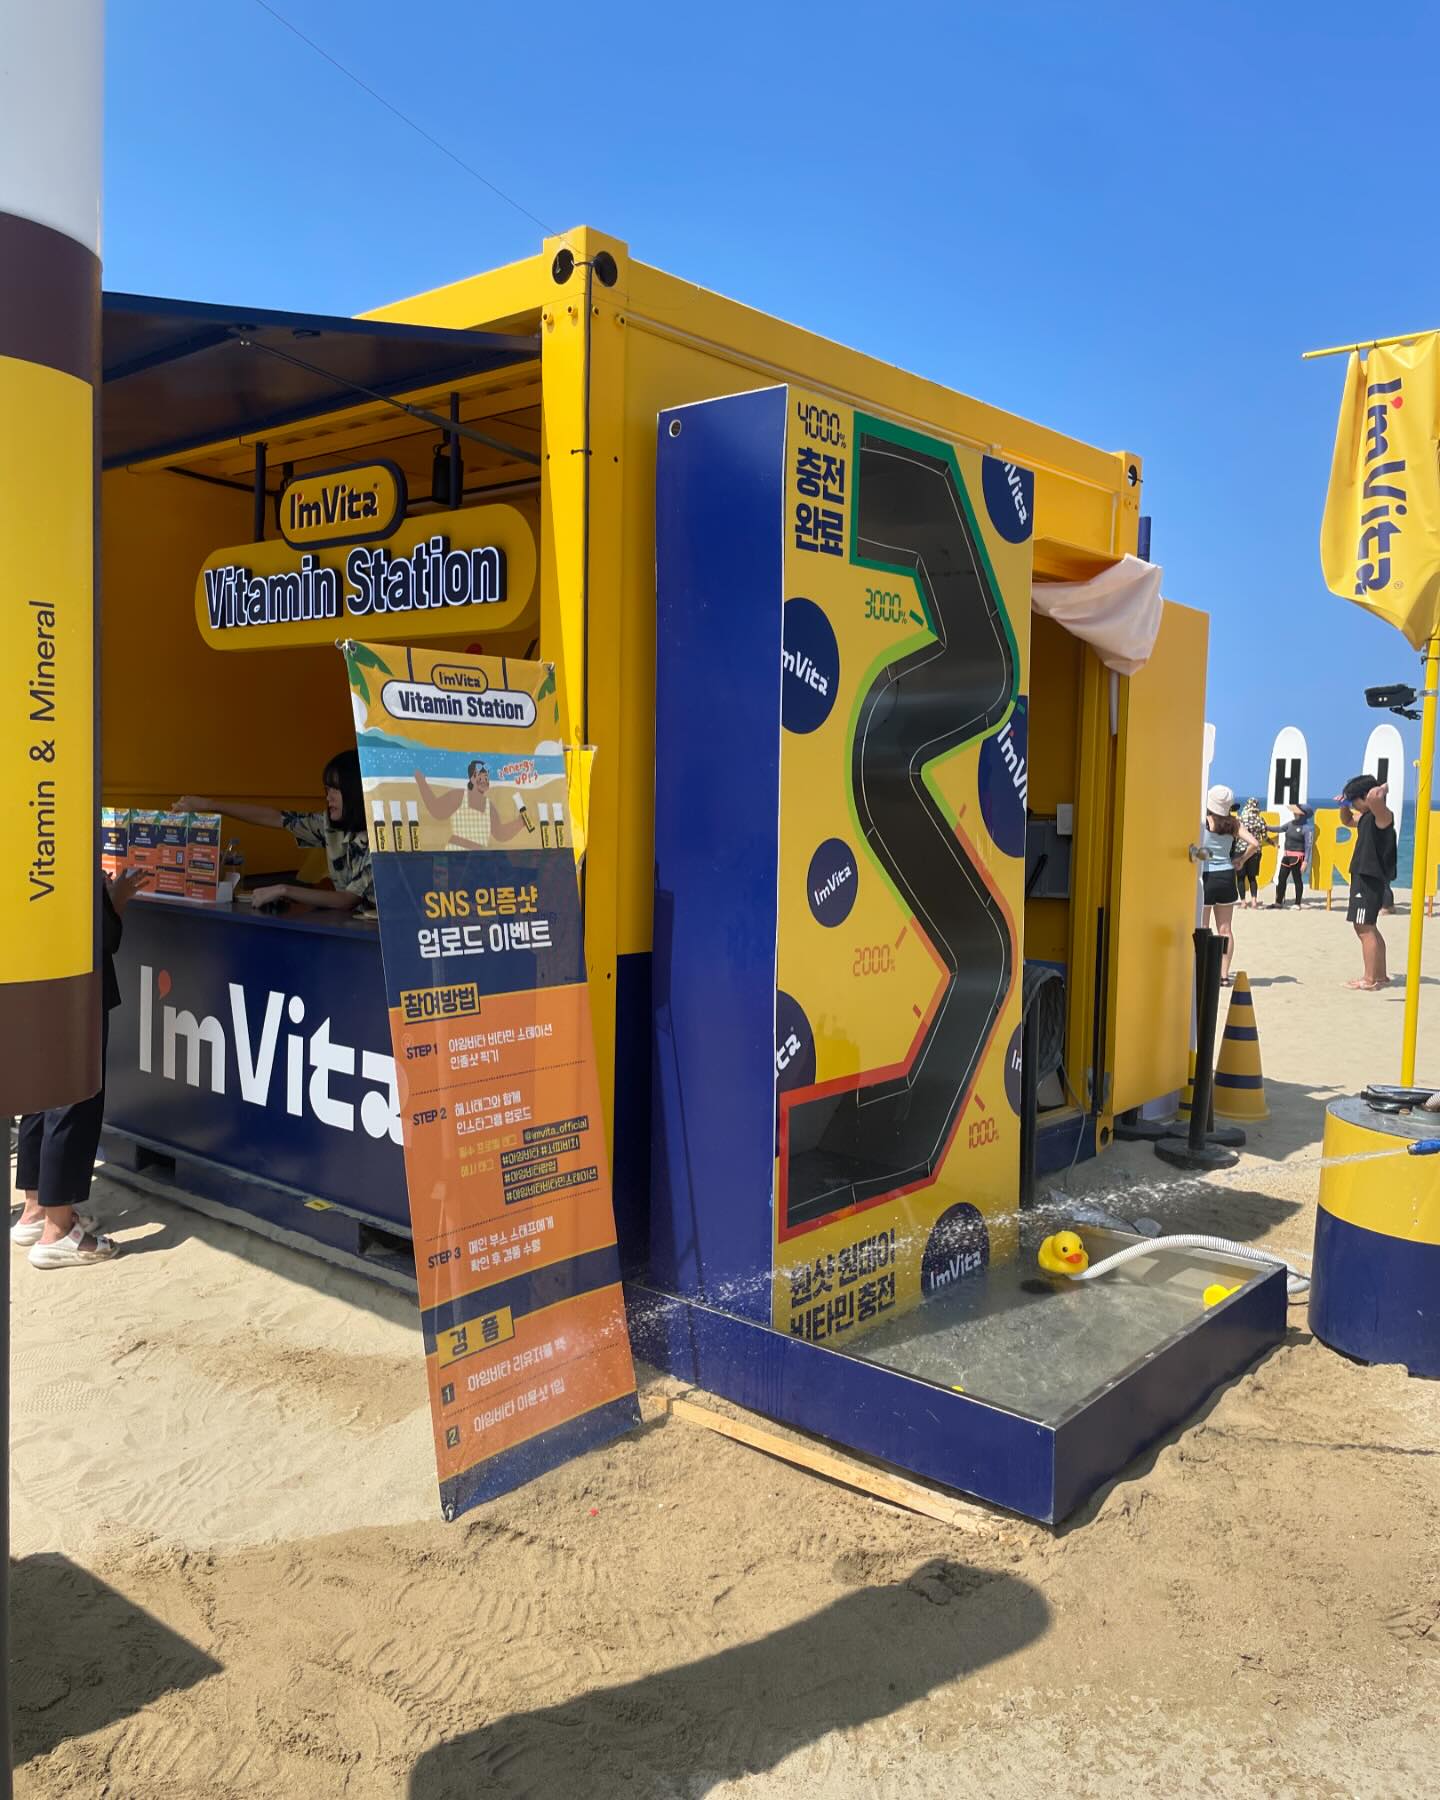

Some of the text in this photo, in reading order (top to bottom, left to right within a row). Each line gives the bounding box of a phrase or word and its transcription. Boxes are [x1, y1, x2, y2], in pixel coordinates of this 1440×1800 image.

[797, 402, 847, 448] 4000%
[796, 446, 846, 506] 충전
[795, 503, 844, 558] 완료
[204, 536, 501, 629] Vitamin Station
[864, 588, 908, 625] 3000%
[398, 689, 525, 721] Vitamin Station
[28, 599, 56, 903] Vitamin & Mineral
[1274, 758, 1301, 805] H
[424, 885, 538, 919] SNS 인증샷
[418, 920, 553, 959] 업로드 이벤트
[404, 986, 475, 1019] 참여방법
[406, 1043, 438, 1060] STEP 1
[487, 1029, 515, 1046] 비타민
[517, 1023, 553, 1041] 스테이션
[450, 1052, 479, 1070] 인증샷
[413, 1109, 447, 1126] STEP 2
[504, 1106, 533, 1125] 업로드
[489, 1231, 508, 1247] 부스
[428, 1247, 461, 1268] STEP 3
[790, 1253, 835, 1309] 원샷
[790, 1271, 896, 1341] 비타민 충전
